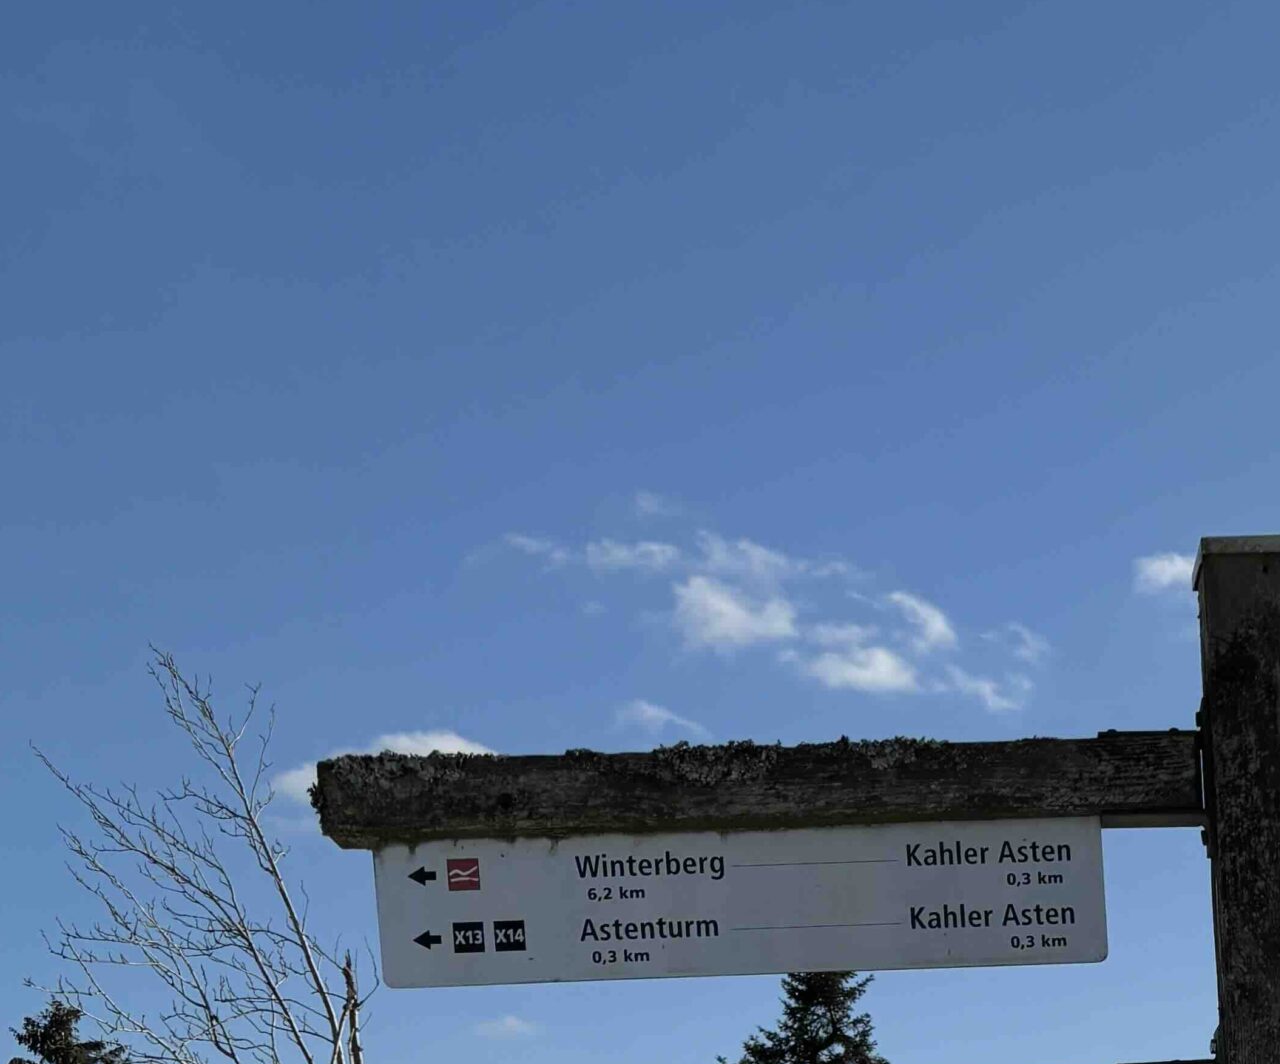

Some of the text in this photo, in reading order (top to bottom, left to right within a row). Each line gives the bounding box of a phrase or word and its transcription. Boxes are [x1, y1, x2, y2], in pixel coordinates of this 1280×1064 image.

[906, 840, 1072, 867] Kahler Asten
[575, 851, 725, 880] Winterberg
[1006, 871, 1063, 887] 0,3 km
[587, 886, 645, 902] 6,2 km
[910, 903, 1075, 930] Kahler Asten
[454, 929, 483, 945] X13
[495, 928, 525, 944] X14
[580, 917, 719, 942] Astenturm
[1010, 934, 1067, 949] 0,3 km
[592, 949, 650, 965] 0,3 km
